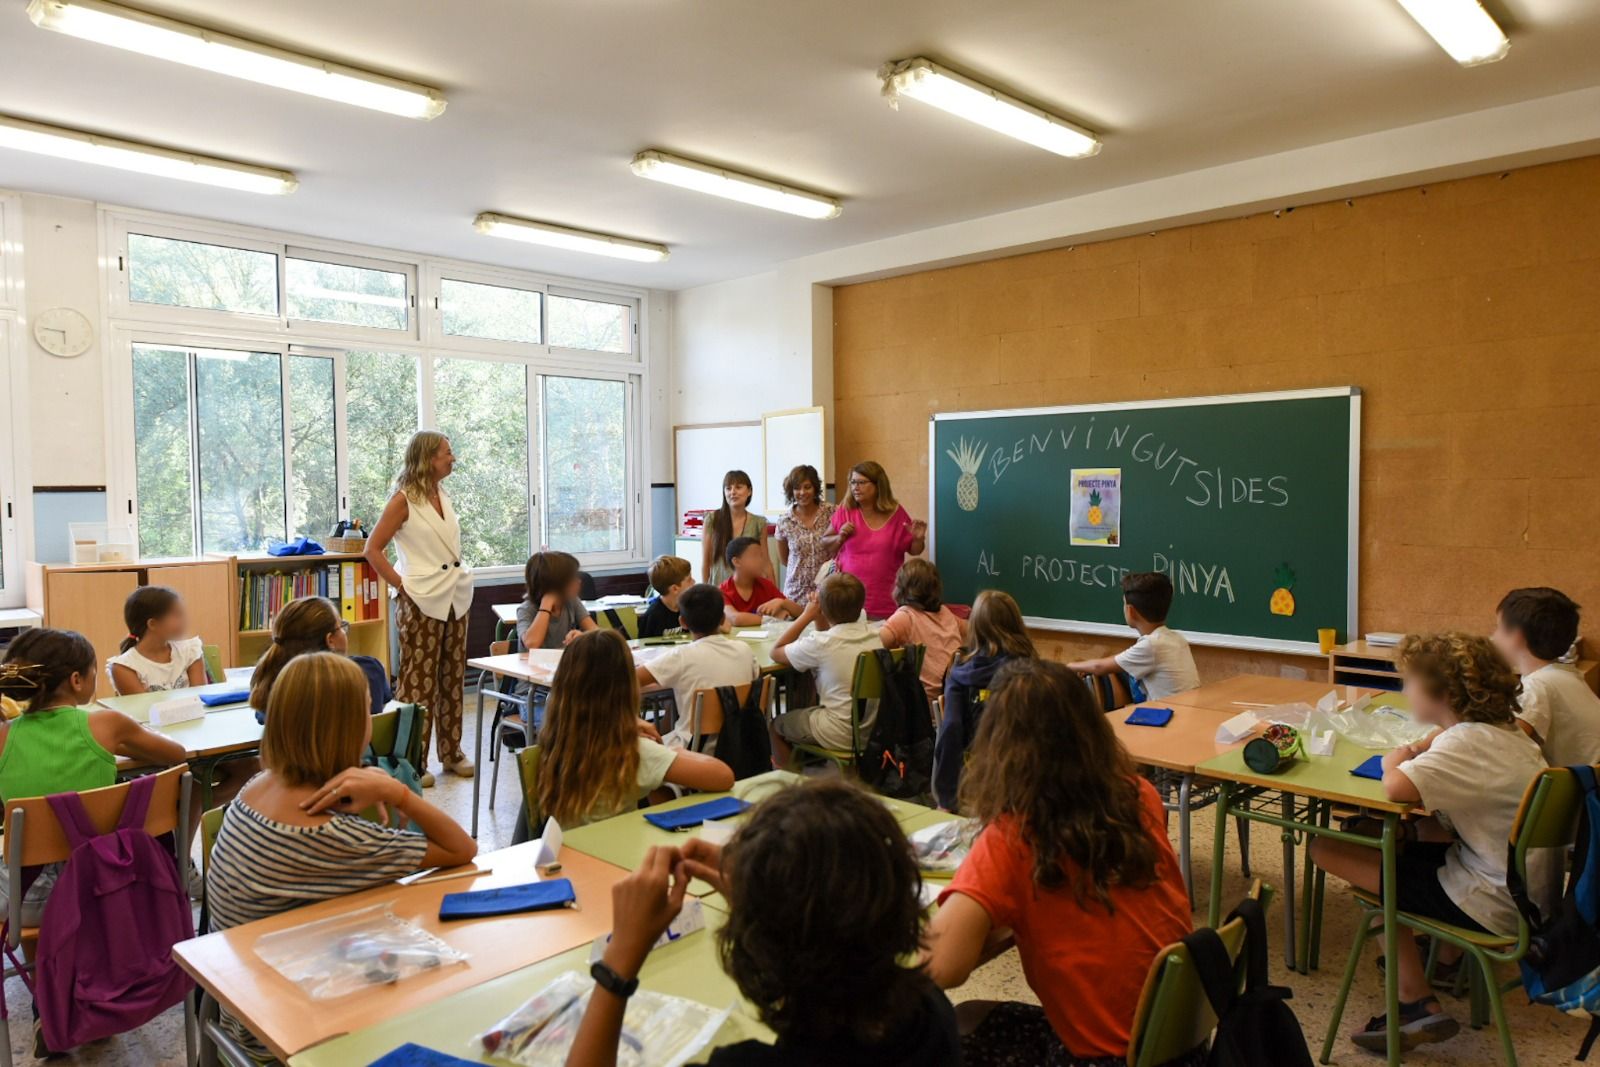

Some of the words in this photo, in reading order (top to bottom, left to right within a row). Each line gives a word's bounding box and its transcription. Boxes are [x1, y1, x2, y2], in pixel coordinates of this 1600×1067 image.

[1101, 479, 1117, 488] PINYA
[976, 549, 1000, 576] AL
[1152, 543, 1236, 604] PINYA
